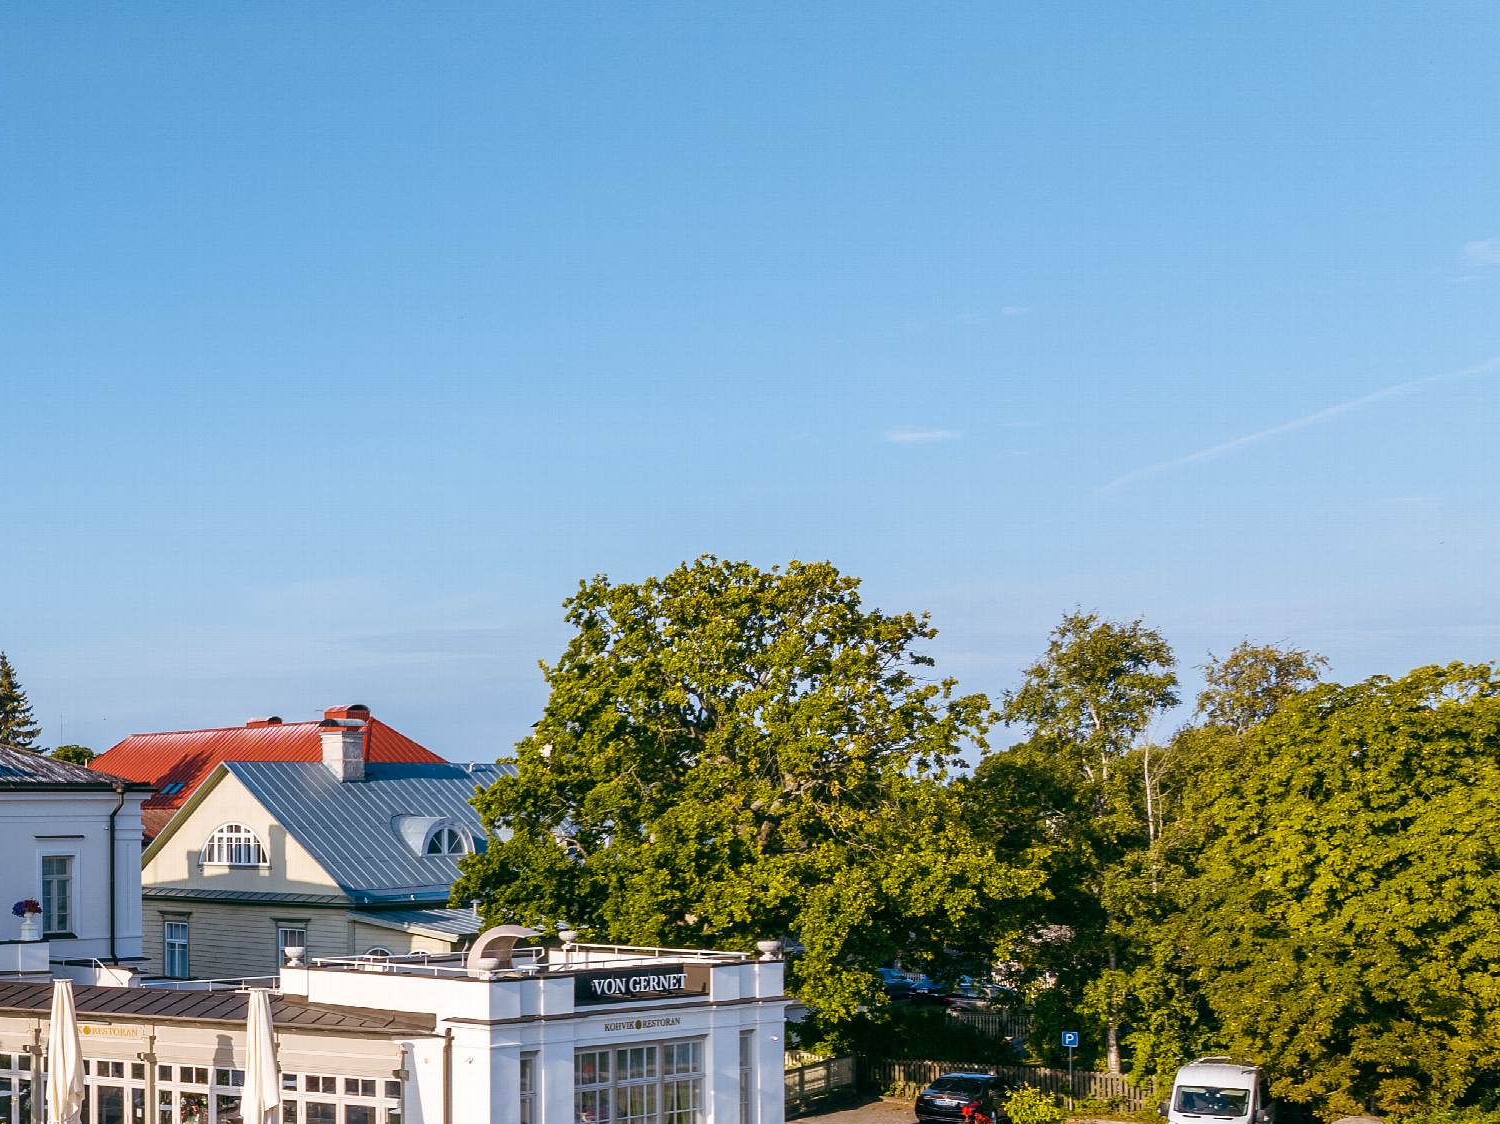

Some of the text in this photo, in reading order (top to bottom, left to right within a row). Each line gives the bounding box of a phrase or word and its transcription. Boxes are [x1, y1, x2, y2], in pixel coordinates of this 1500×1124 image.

[593, 973, 687, 995] VON GERNET
[604, 1017, 681, 1032] KOHVIK RESTORAN
[92, 1027, 138, 1037] RESTORAN
[1065, 1033, 1075, 1045] P
